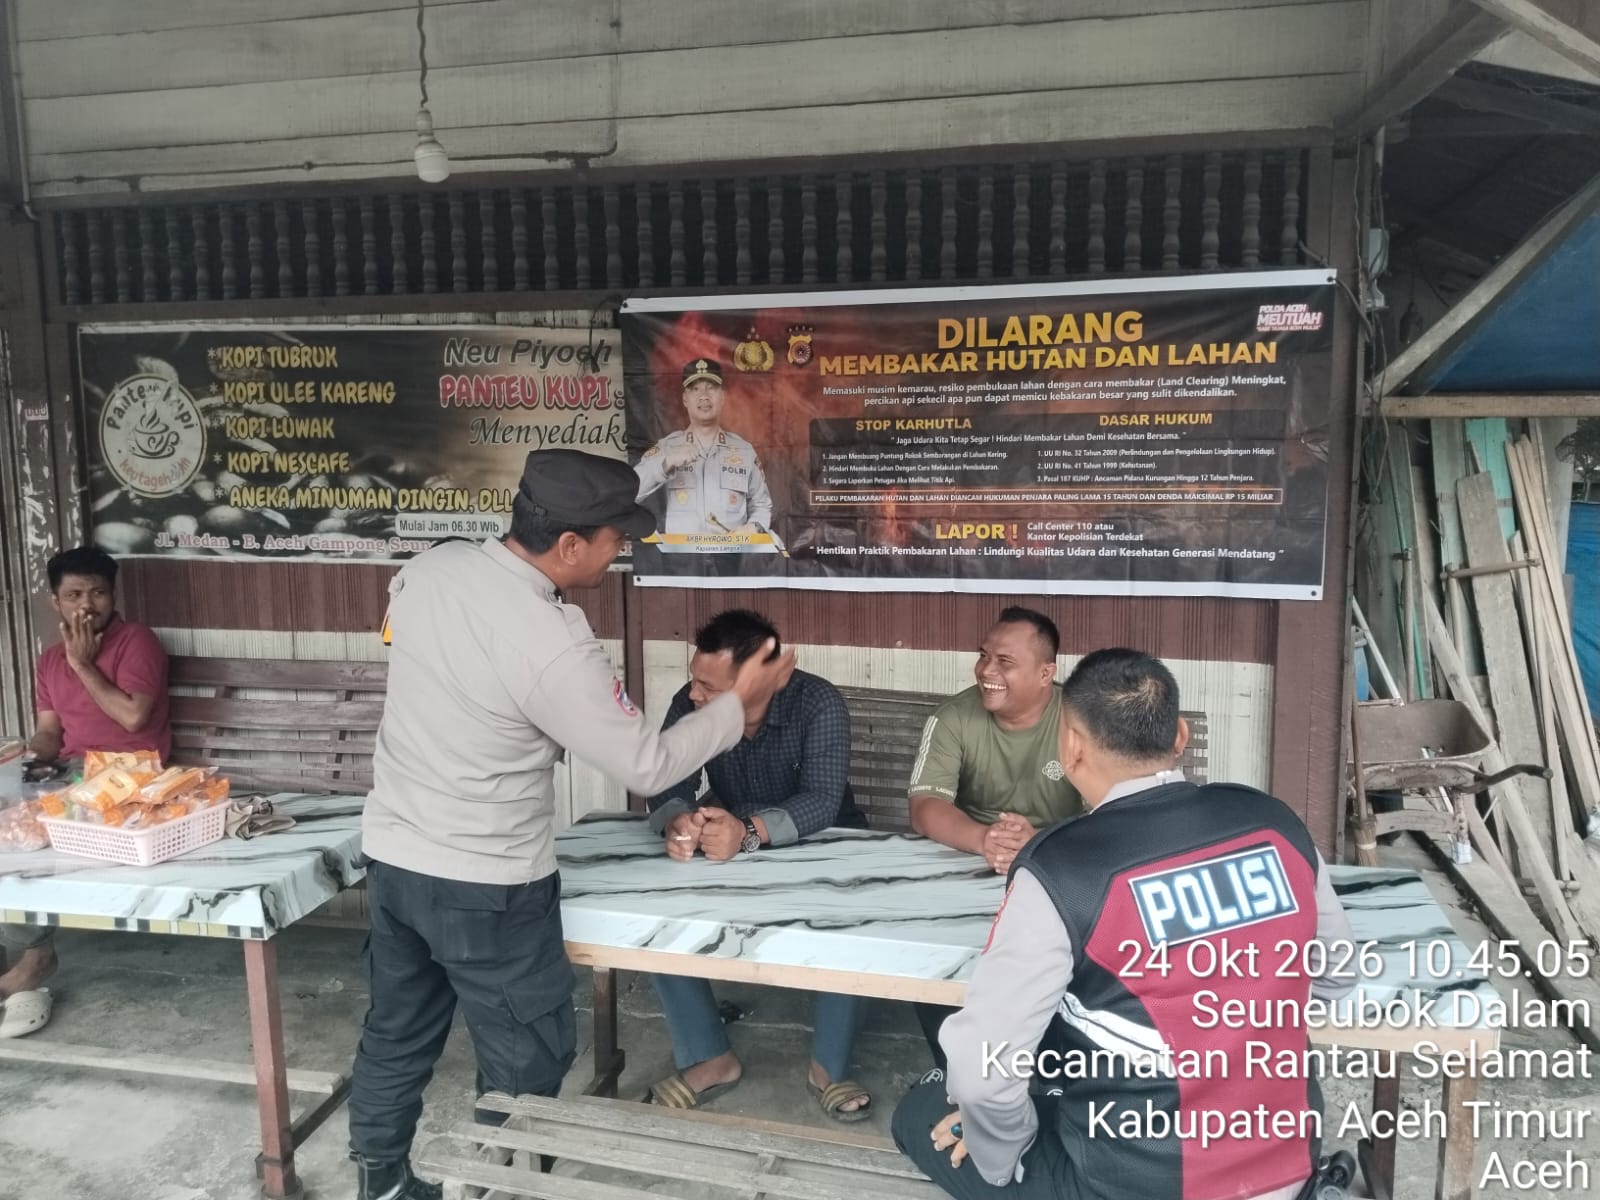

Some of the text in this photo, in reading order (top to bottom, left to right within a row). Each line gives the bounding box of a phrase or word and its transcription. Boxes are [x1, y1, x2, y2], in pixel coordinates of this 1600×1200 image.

[1257, 312, 1322, 326] MEUTUAH
[938, 311, 1143, 349] DILARANG
[222, 346, 338, 368] KOPI TUBRUK
[445, 339, 501, 365] Neu
[820, 341, 1277, 376] MEMBAKAR HUTAN DAN LAHAN
[224, 381, 396, 404] KOPI ULEE KARENG
[440, 374, 610, 408] PANTEU KUPI
[823, 375, 1286, 395] Memasuki musim kemarau, resiko pembukaan lahan dengan cara membakar (Land Clearing) Meningkat,
[864, 387, 1237, 407] percikan api sekecil apa pun dapat memicu kebakaran besar yang sulit dikendalikan.
[226, 416, 335, 438] KOPI LUWAK
[856, 418, 972, 431] STOP KARHUTLA
[1100, 413, 1213, 426] DASAR HUKUM
[896, 431, 1180, 445] Jaga Udara Kita Tetap Segar Hindari Membakar Lahan Demi Kesehatan Bersama.
[1214, 448, 1250, 457] Lingkungan
[228, 452, 350, 474] KOPI NESCAFE
[722, 466, 747, 475] POLRI
[1145, 474, 1175, 482] Kurungan
[1176, 474, 1199, 482] Hingga
[230, 486, 289, 508] ANEKA
[295, 486, 392, 510] MINUMAN
[398, 488, 475, 513] DINGIN,
[840, 494, 884, 502] PEMBAKARAN
[885, 494, 908, 502] HUTAN
[1021, 493, 1052, 501] PENJARA
[1054, 493, 1079, 501] PALING
[400, 520, 499, 533] Mulai Jam 06.30 Wib
[935, 523, 1018, 540] LAPOR !
[1027, 522, 1114, 531] Call Center 110 atau
[155, 532, 433, 556] Jl. Medan B. Aceh Gampong Seun
[1027, 532, 1144, 542] Kantor Kepolisian Terdekat
[817, 545, 1276, 561] Hentikan Praktik Pembakaran Lahan Lindungi Kualitas Udara dan Kesehatan Generasi Mendatang
[1137, 853, 1293, 938] POLISI
